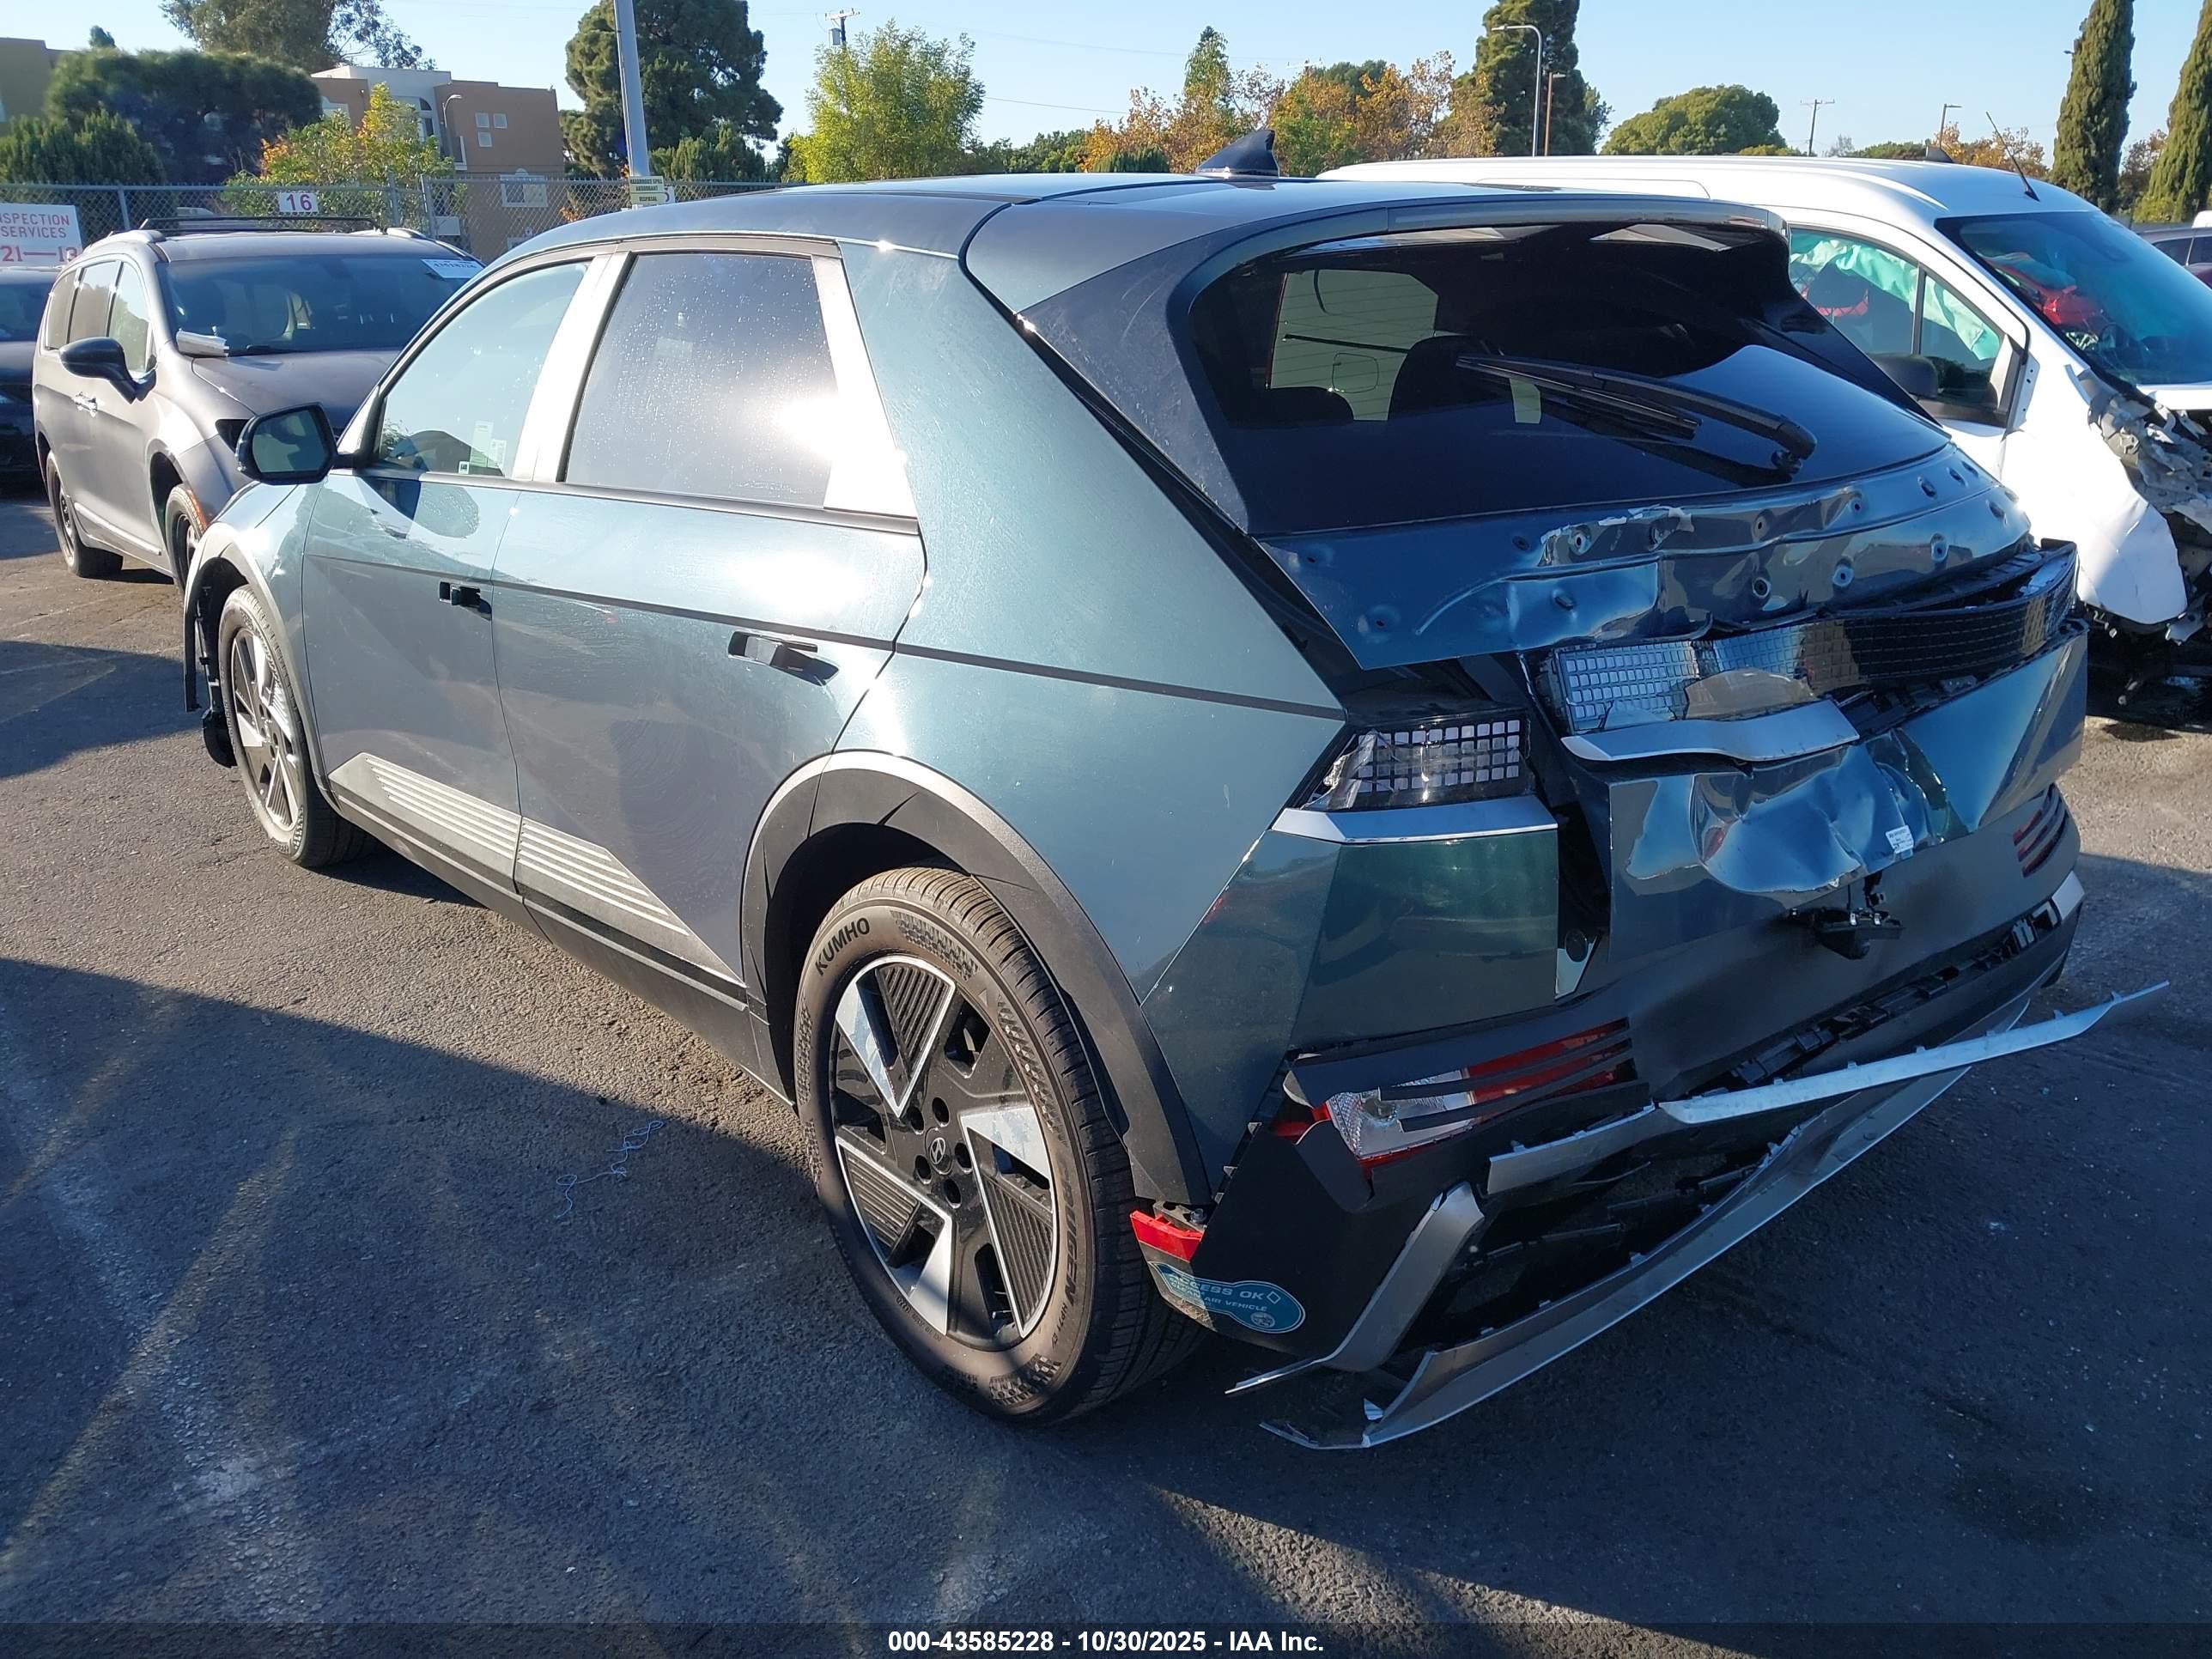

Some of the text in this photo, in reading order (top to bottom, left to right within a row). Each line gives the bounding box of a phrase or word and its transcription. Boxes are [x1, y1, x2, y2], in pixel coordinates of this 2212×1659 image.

[286, 193, 313, 211] 16
[0, 212, 70, 226] SPECTION
[0, 226, 67, 239] SERVICES
[815, 917, 870, 976] KUMHO
[1239, 1291, 1264, 1300] OK
[1225, 1299, 1267, 1311] VEHICLE
